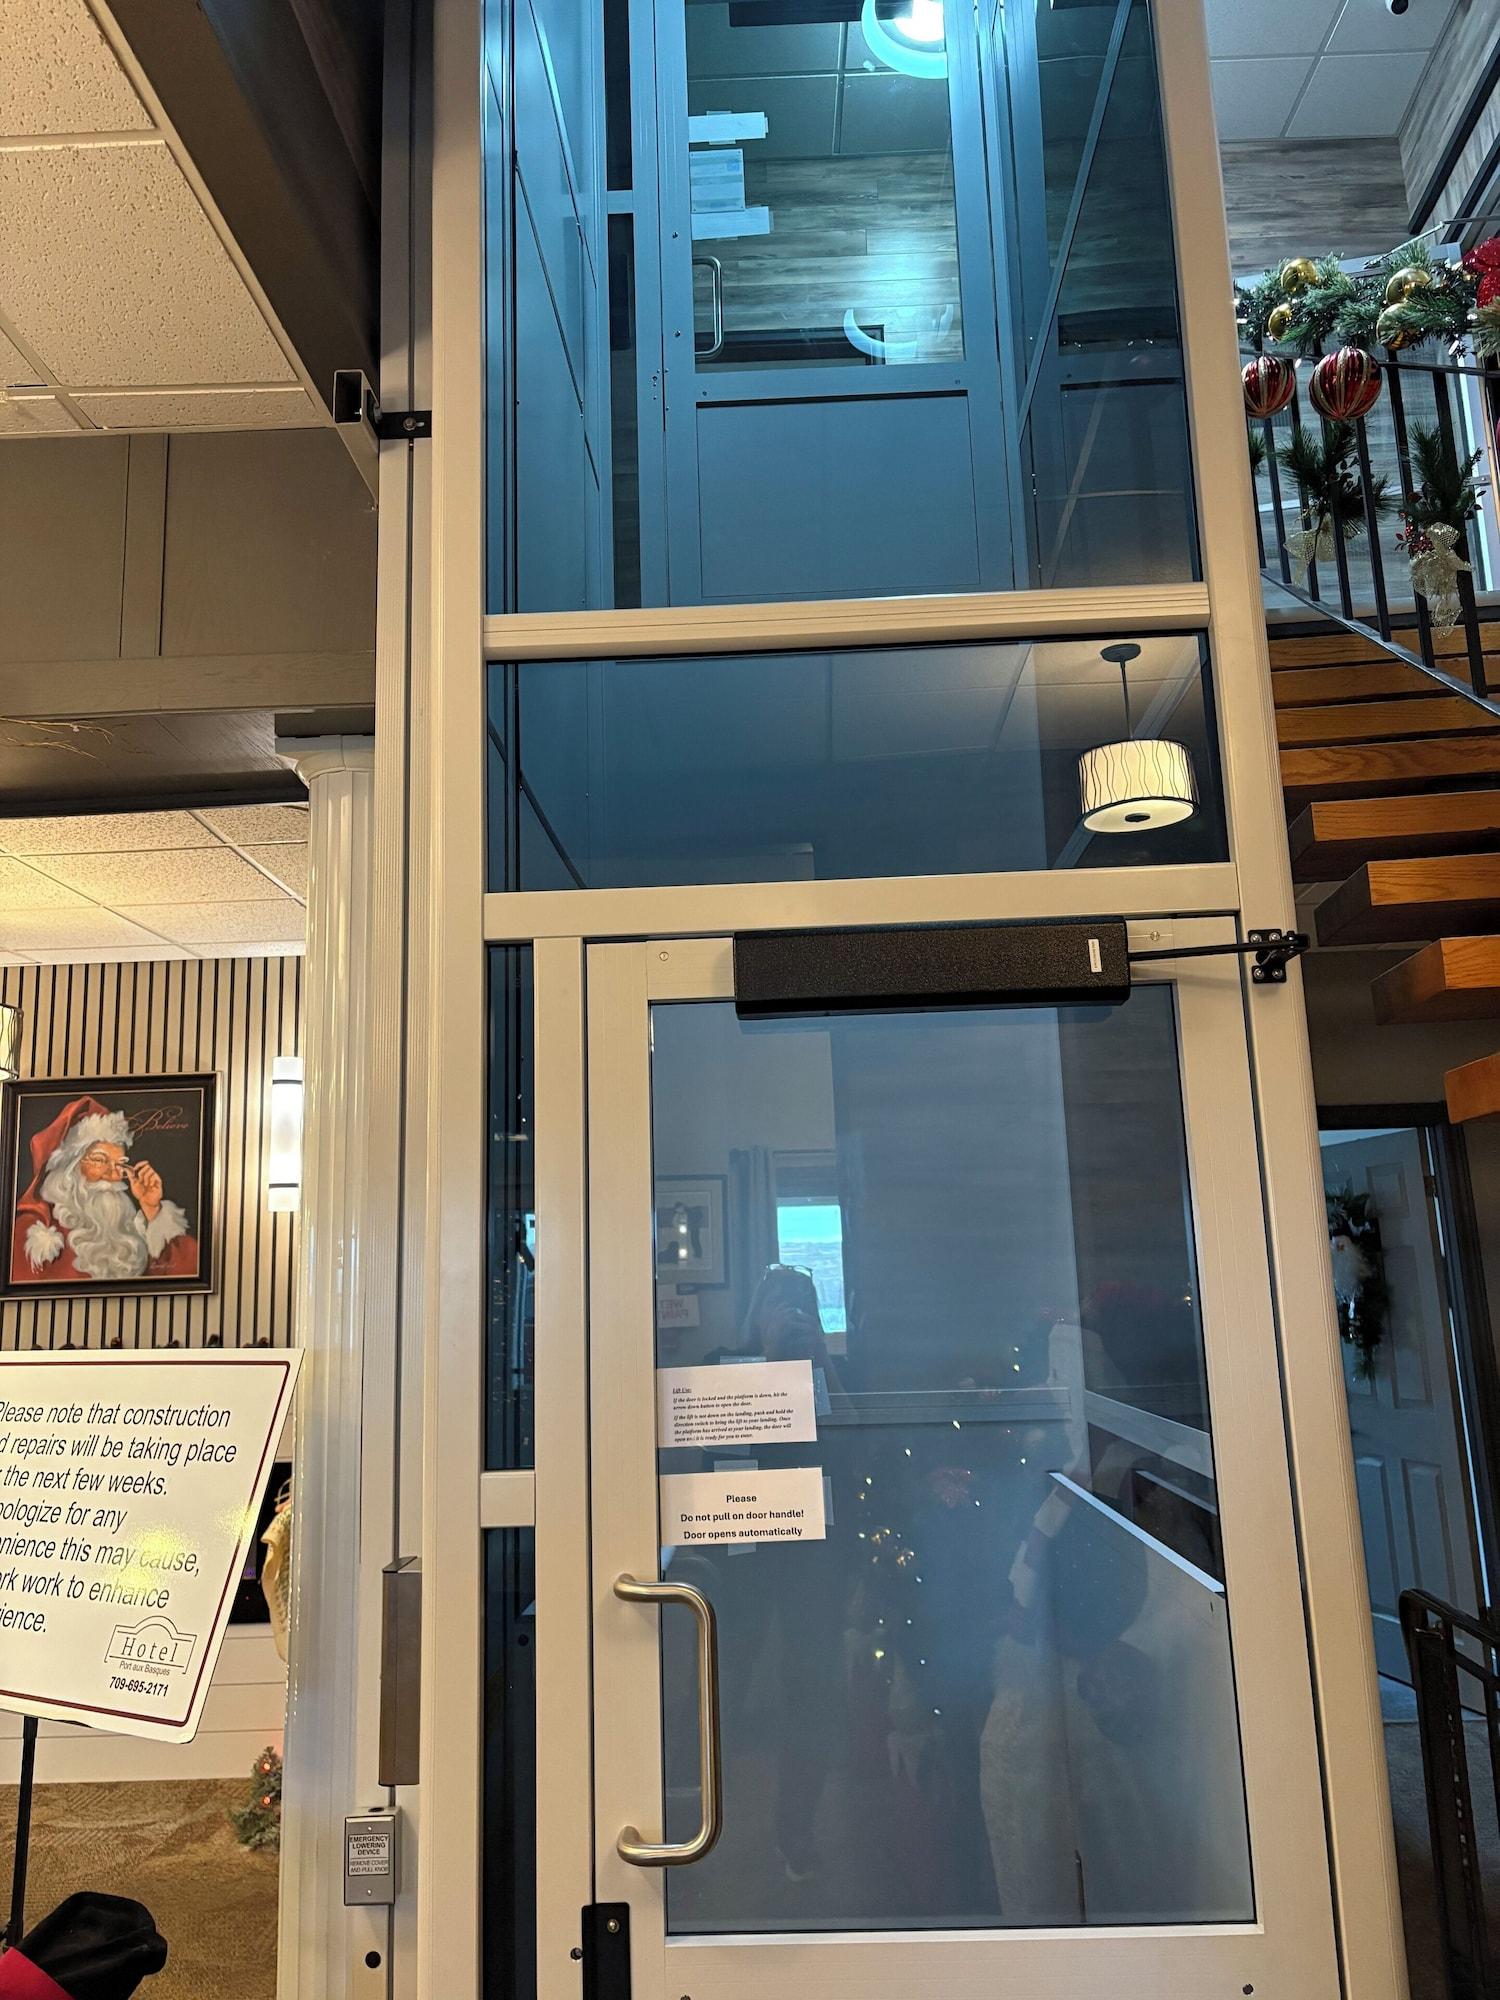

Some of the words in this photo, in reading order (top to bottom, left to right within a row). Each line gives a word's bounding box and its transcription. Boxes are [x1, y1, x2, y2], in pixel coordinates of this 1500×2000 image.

[46, 1403, 83, 1423] note
[87, 1402, 120, 1424] that
[124, 1404, 230, 1427] construction
[11, 1434, 66, 1460] repairs
[71, 1434, 100, 1456] will
[101, 1435, 123, 1457] be
[128, 1437, 182, 1466] taking
[184, 1438, 236, 1467] place
[4, 1465, 29, 1486] the
[33, 1468, 70, 1489] next
[72, 1468, 105, 1491] few
[109, 1471, 166, 1495] weeks.
[726, 1495, 757, 1503] Please
[65, 1502, 91, 1525] for
[93, 1509, 128, 1534] any
[680, 1514, 693, 1522] Do
[695, 1513, 711, 1521] not
[713, 1512, 730, 1522] pull
[746, 1512, 767, 1520] door
[769, 1510, 804, 1518] handle!
[684, 1531, 706, 1539] Door
[708, 1530, 737, 1540] opens
[739, 1527, 802, 1536] automatically
[0, 1532, 55, 1558] nience
[60, 1537, 91, 1562] this
[95, 1545, 136, 1572] may
[140, 1551, 199, 1577] cause,
[22, 1571, 64, 1596] work
[67, 1574, 84, 1598] to
[89, 1578, 170, 1608] enhance
[0, 1602, 46, 1632] ience.
[121, 1637, 178, 1662] Hotel
[120, 1661, 132, 1670] Port
[144, 1664, 170, 1676] Basques
[109, 1677, 168, 1697] 709-695-2171
